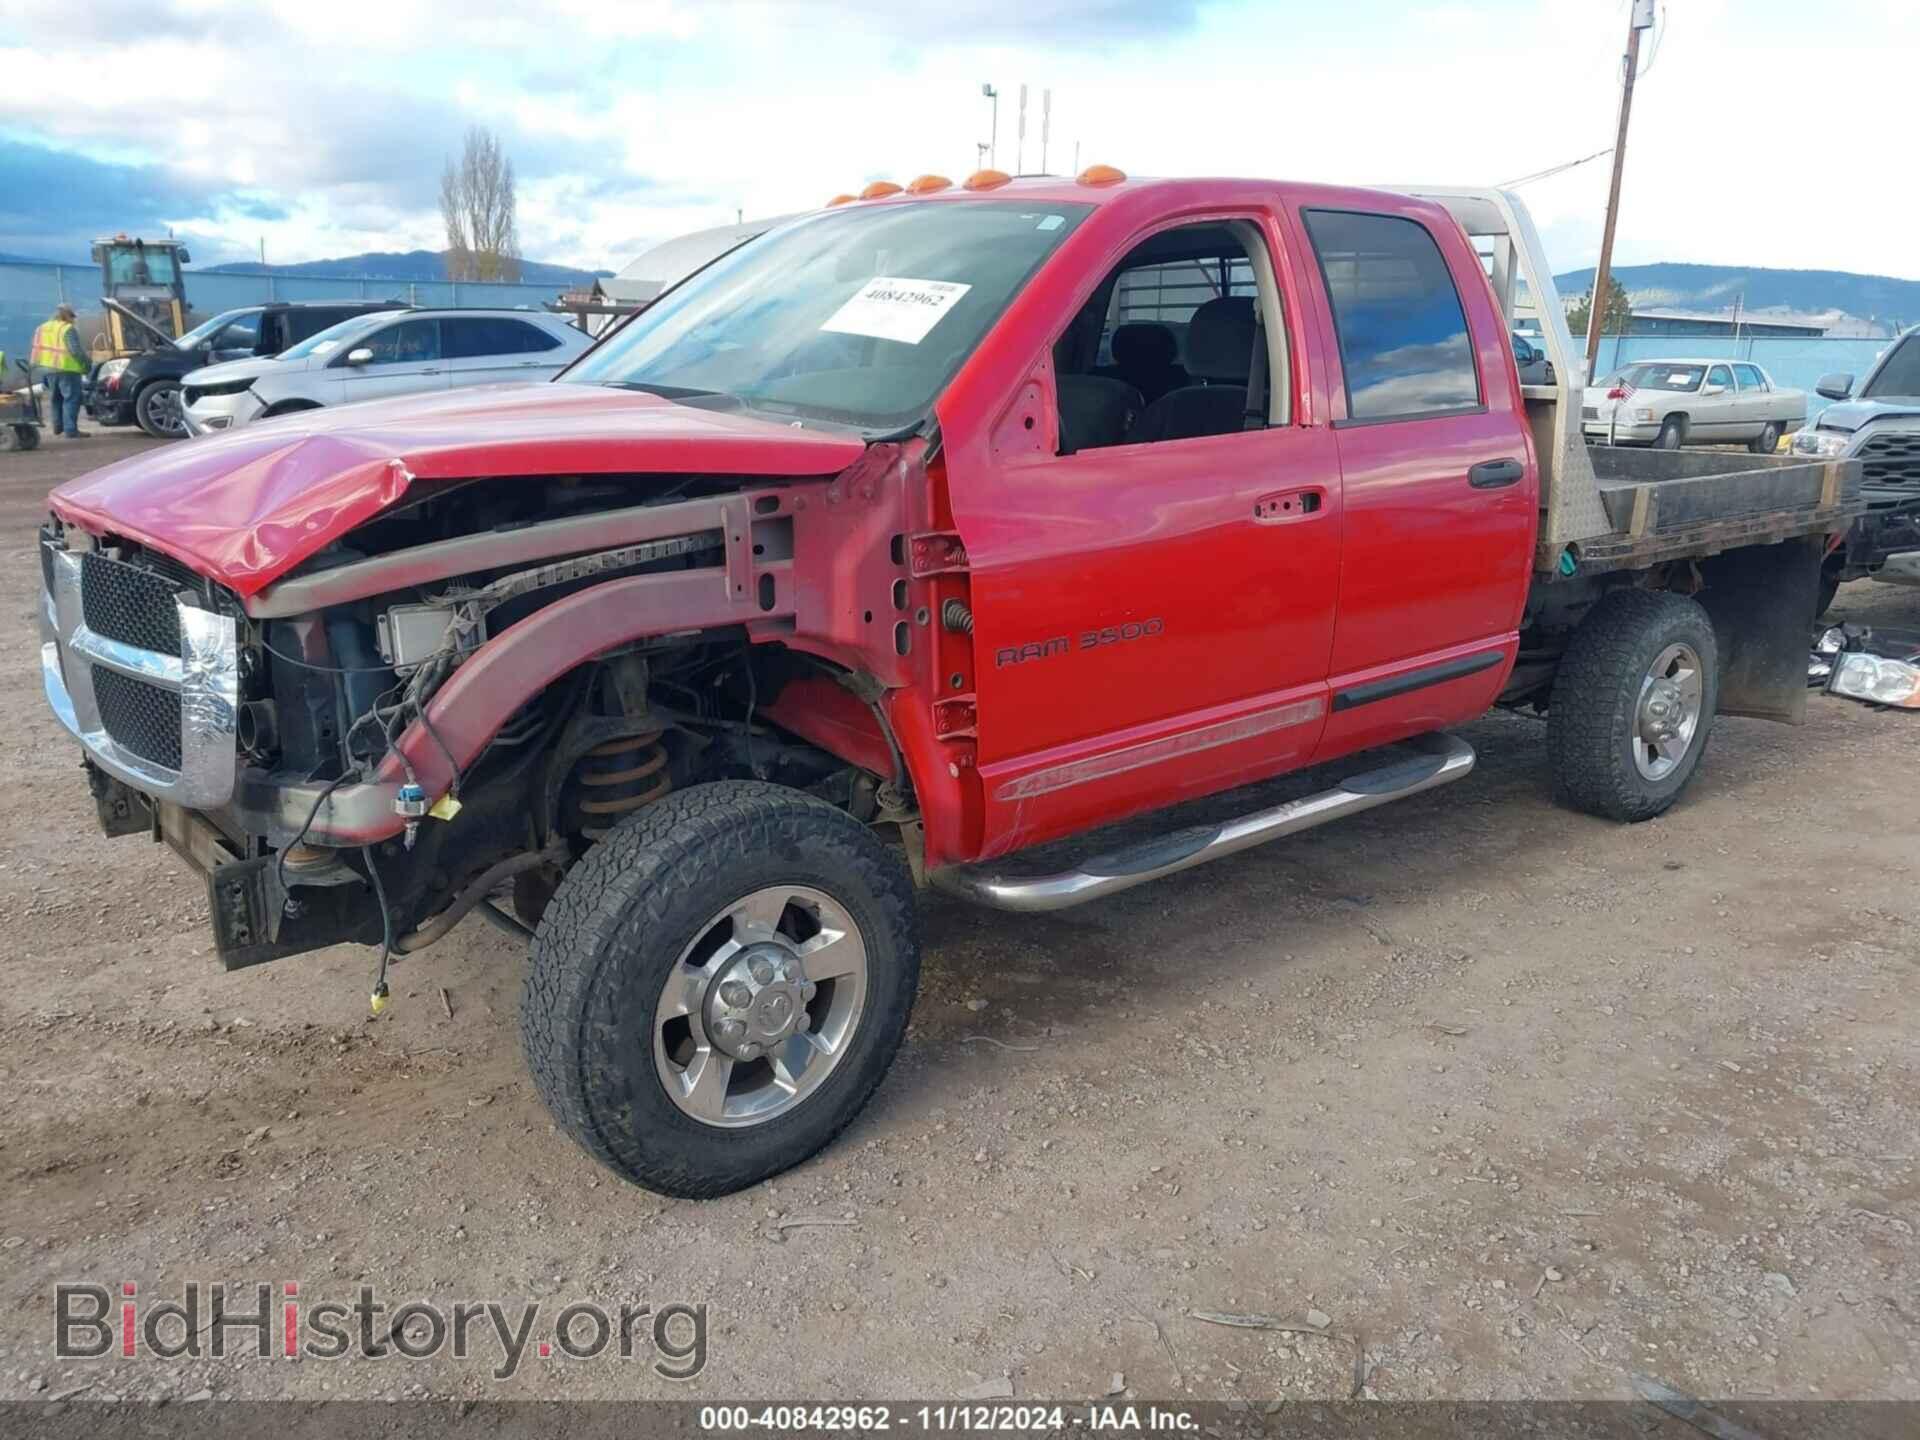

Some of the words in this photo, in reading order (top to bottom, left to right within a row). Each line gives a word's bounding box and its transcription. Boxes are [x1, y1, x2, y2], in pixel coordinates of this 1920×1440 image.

[866, 289, 945, 306] 40842962
[996, 637, 1069, 668] RAM
[1079, 618, 1164, 650] 3500
